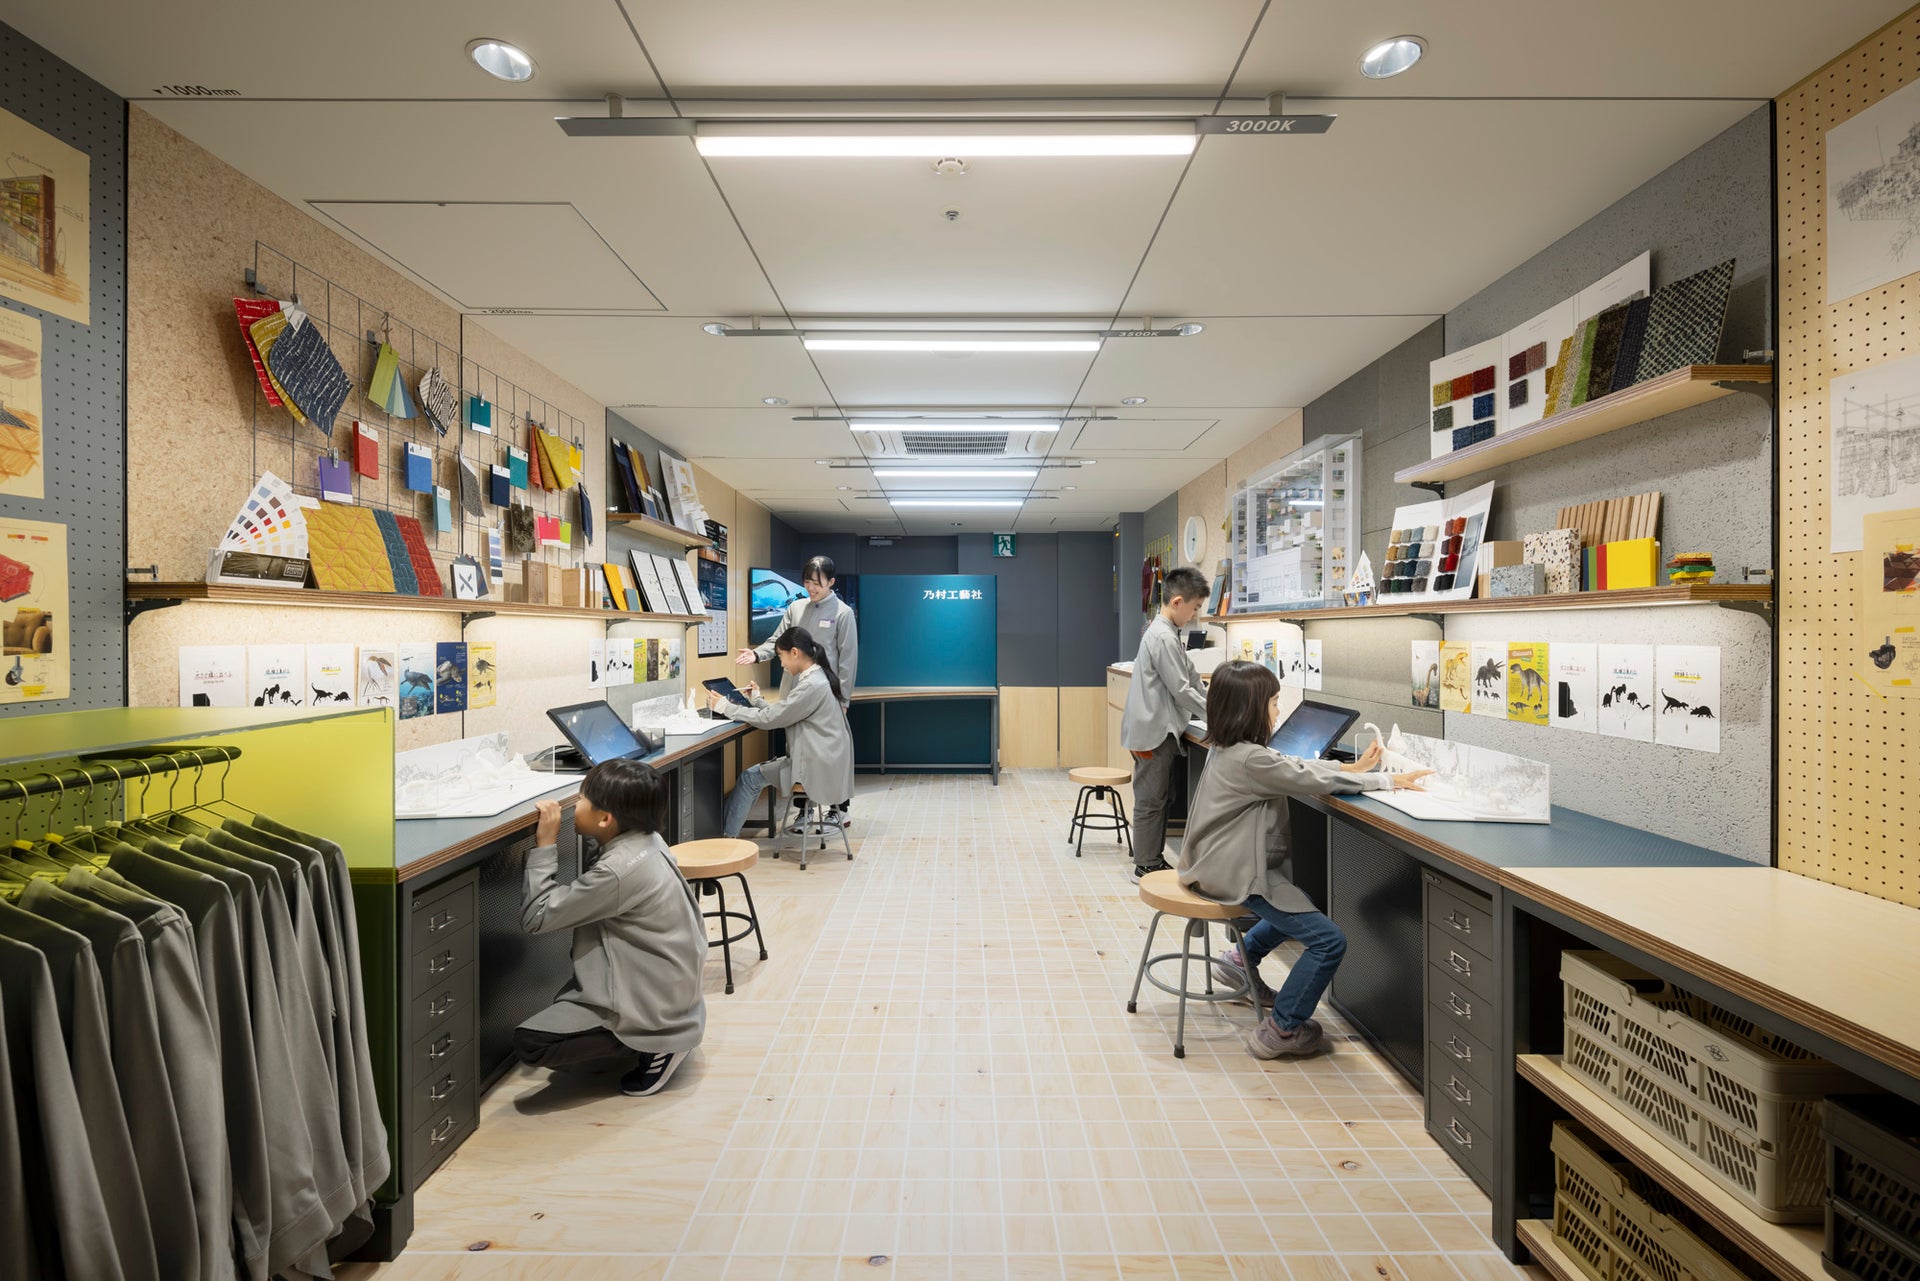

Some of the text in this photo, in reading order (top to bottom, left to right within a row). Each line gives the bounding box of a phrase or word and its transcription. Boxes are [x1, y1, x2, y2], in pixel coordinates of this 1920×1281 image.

[162, 85, 242, 96] 1000mm
[1226, 120, 1296, 132] 3000K
[922, 589, 983, 600] 乃村工藝社
